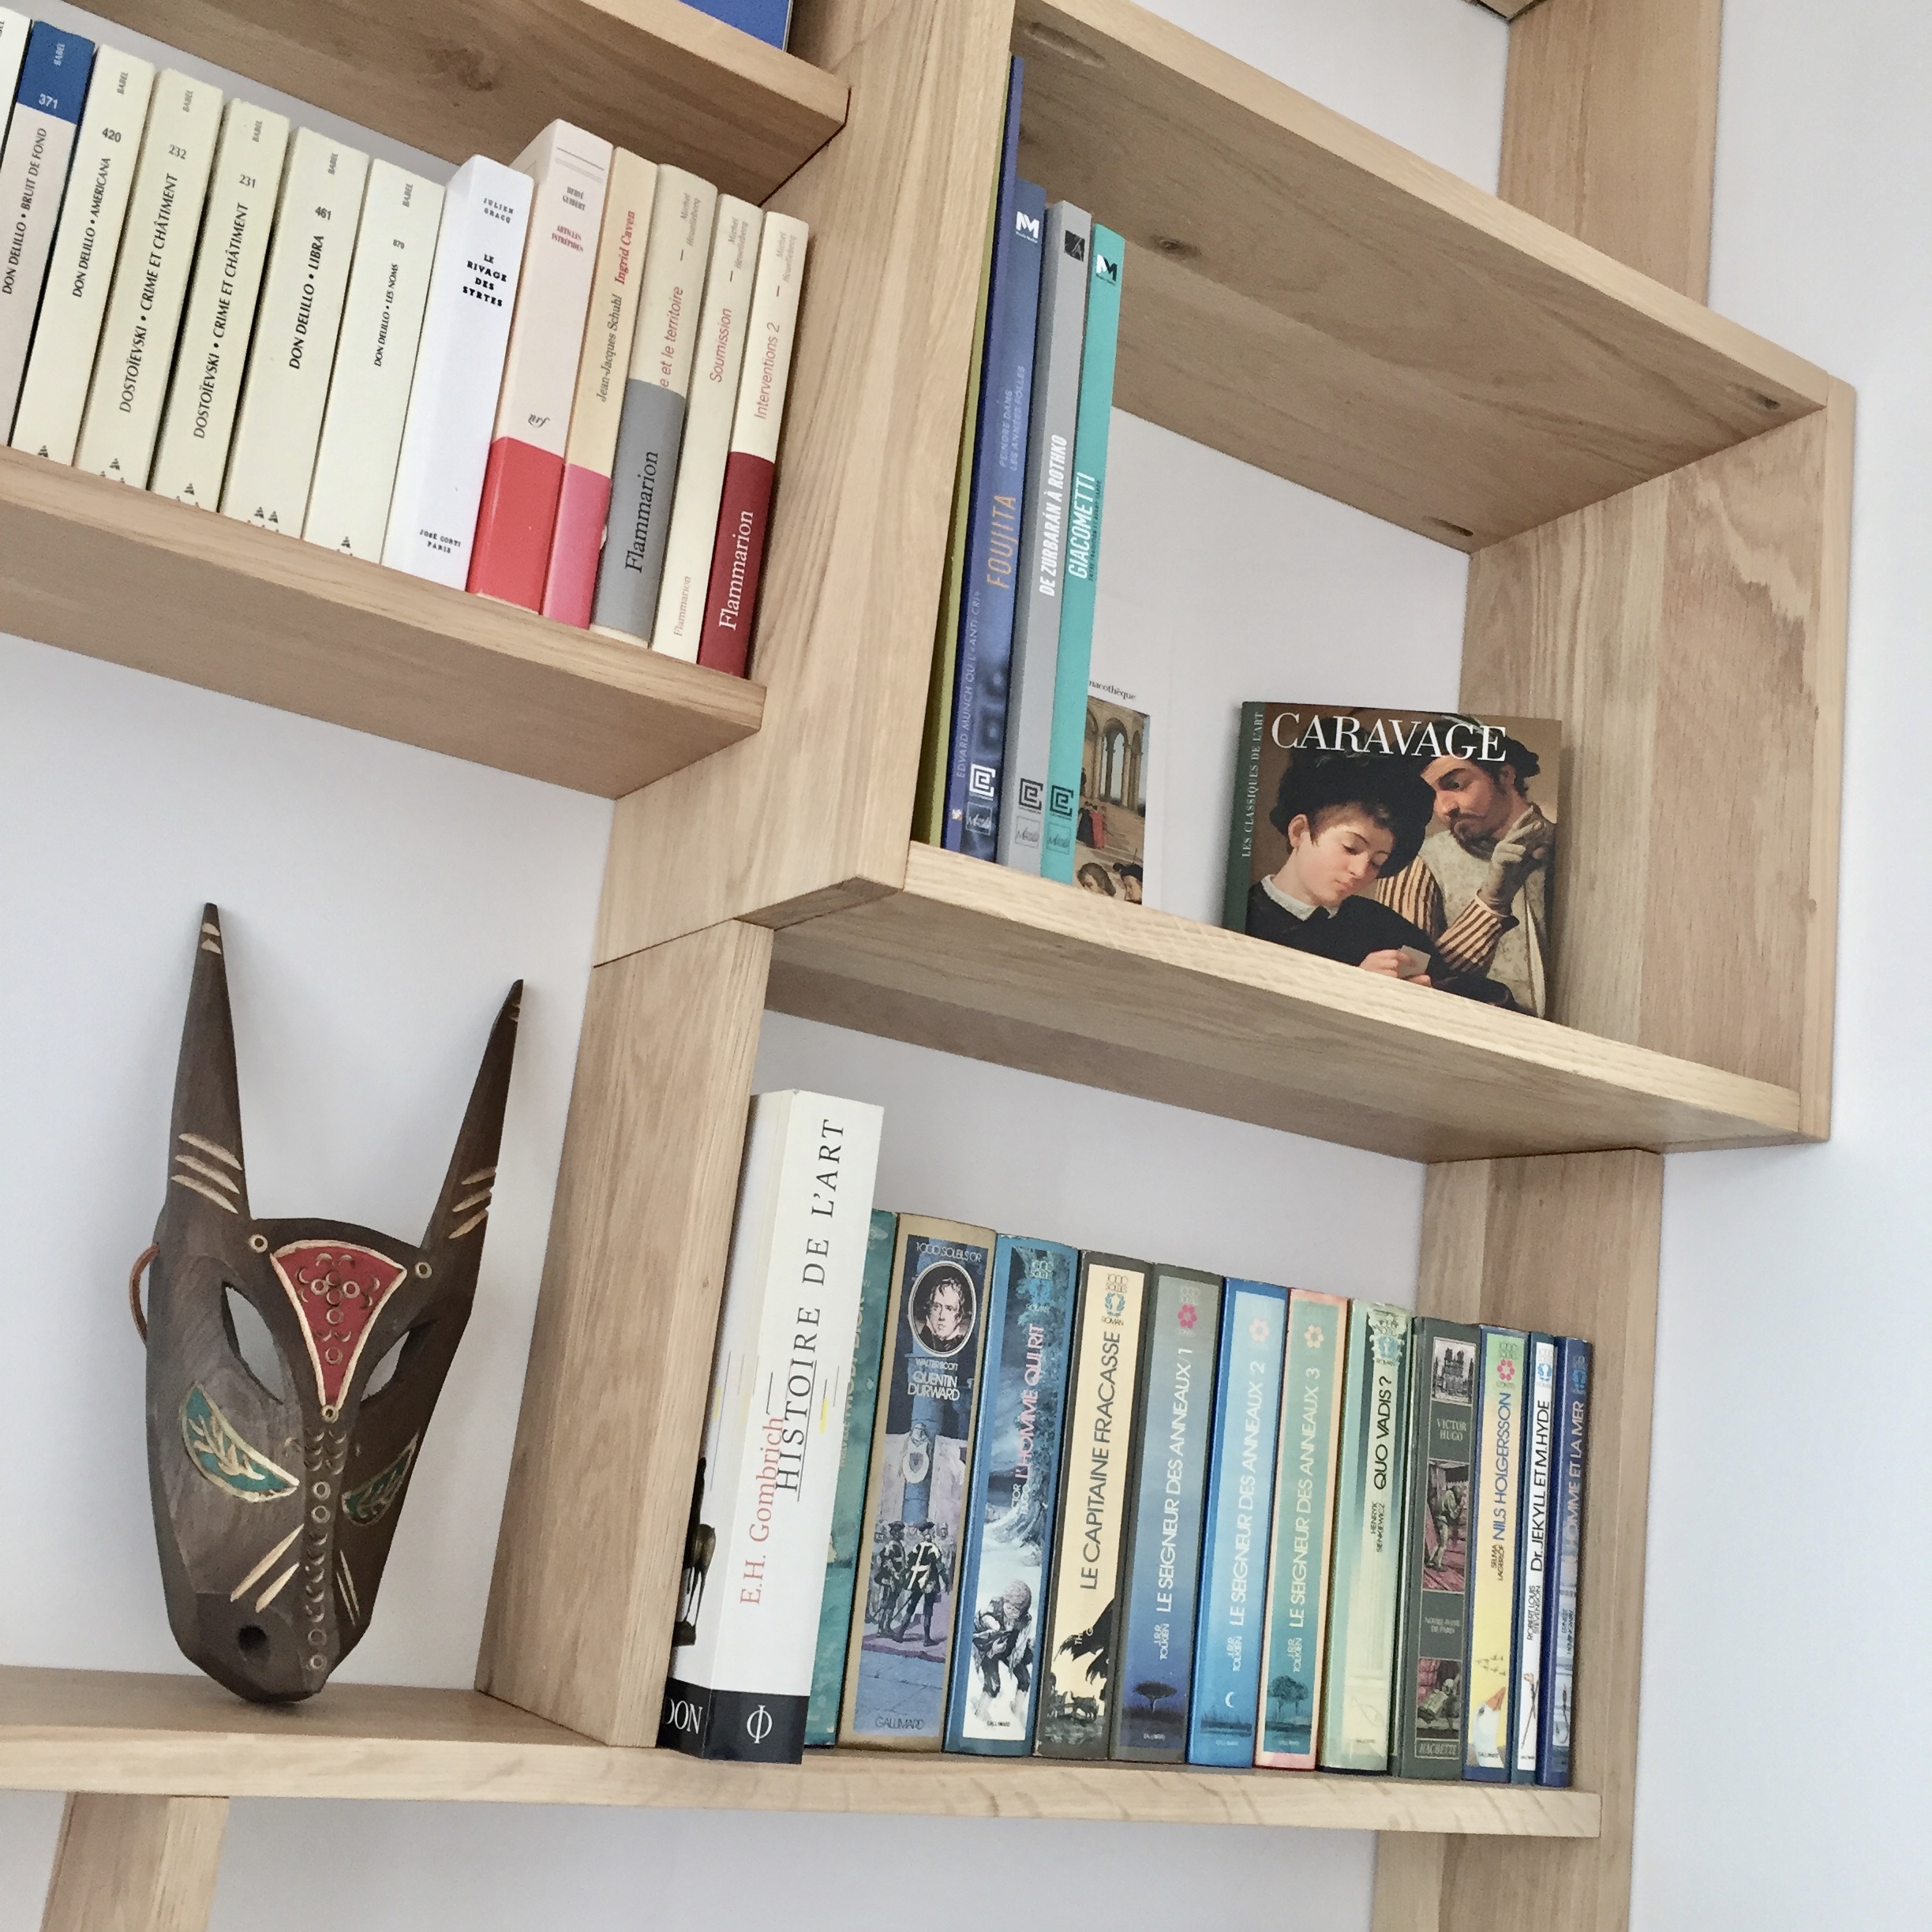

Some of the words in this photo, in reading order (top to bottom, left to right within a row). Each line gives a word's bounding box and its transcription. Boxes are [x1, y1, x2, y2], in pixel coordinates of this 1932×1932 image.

[117, 72, 129, 94] BABEL
[39, 93, 58, 110] 371
[182, 89, 193, 113] BABEL
[32, 128, 47, 161] FOND
[101, 128, 122, 143] 420
[252, 120, 263, 143] BABEL
[168, 144, 187, 160] 232
[328, 152, 339, 175] BABEL
[28, 161, 40, 178] DE
[238, 174, 256, 189] 231
[20, 178, 36, 212] BRUIT
[90, 158, 111, 219] AMERICANA
[402, 183, 414, 208] BABEL
[152, 174, 178, 251] CHÂTIMENT
[315, 206, 331, 221] 461
[483, 197, 514, 215] JULIEN
[484, 208, 511, 224] GRACQ
[224, 202, 249, 279] CHÂTIMENT
[620, 210, 635, 248] Caven
[8, 221, 27, 271] DELILLO
[78, 227, 96, 271] DELILLO
[148, 251, 163, 269] ET
[307, 235, 324, 271] LIBRA
[484, 253, 495, 264] LE
[2, 268, 17, 295] DON
[388, 264, 399, 289] NOMS
[466, 260, 507, 283] RIVAGE
[614, 246, 630, 286] Ingrid
[72, 271, 86, 297] DON
[140, 269, 159, 311] CRIME
[220, 279, 234, 298] ET
[384, 290, 395, 305] LES
[462, 286, 503, 307] SYRTES
[475, 277, 495, 290] DES
[212, 298, 232, 339] CRIME
[295, 283, 315, 336] DELILLO
[606, 293, 623, 331] Schuhl
[664, 286, 683, 343] territoire
[377, 311, 391, 346] DELILLO
[289, 336, 305, 369] DON
[373, 346, 384, 367] DON
[661, 343, 676, 360] le
[710, 307, 732, 384] Soumission
[119, 325, 148, 414] DOSTOÏEVSKI
[596, 332, 617, 403] Jean-Jacques
[660, 360, 673, 376] et
[754, 336, 778, 421] Interventions
[766, 321, 781, 333] 2
[193, 352, 221, 440] DOSTOÏEVSKI
[527, 413, 551, 428] nrf
[1046, 434, 1068, 492] ROTHKO
[624, 450, 660, 574] Flammarion
[1043, 491, 1063, 504] À
[987, 494, 1019, 590] FOUJITA
[1040, 502, 1062, 577] ZURBARÁN
[1068, 471, 1096, 580] GIACOMETTI
[427, 541, 451, 555] PARIS
[718, 510, 754, 632] Flammarion
[1039, 575, 1056, 597] DE
[673, 575, 691, 637] Flammarion
[965, 662, 975, 683] OU
[962, 686, 973, 731] MUNCH
[1251, 746, 1261, 760] DE
[1271, 712, 1507, 762] CARAVAGE
[956, 732, 969, 779] EDVARD
[1245, 765, 1260, 833] CLASSIQUES
[1241, 837, 1252, 857] LES
[811, 1118, 844, 1219] L'ART
[802, 1238, 829, 1286] DE
[915, 1241, 941, 1256] 1000
[1028, 1323, 1045, 1347] RIT
[1101, 1315, 1125, 1327] ROMAN
[912, 1370, 958, 1388] QUENTIN
[1024, 1346, 1043, 1387] QUI
[1249, 1360, 1266, 1374] 2
[1305, 1367, 1320, 1380] 3
[776, 1307, 821, 1492] HISTOIRE
[908, 1382, 960, 1402] DURWARD
[1095, 1331, 1121, 1443] FRACASSE
[1242, 1382, 1264, 1473] ANNEAUX
[1300, 1384, 1320, 1477] ANNEAUX
[1376, 1388, 1392, 1440] VADIS
[1436, 1418, 1467, 1432] VICTOR
[1571, 1400, 1585, 1436] MER
[1015, 1391, 1039, 1480] L'HOMME
[1440, 1430, 1464, 1443] HUGO
[1494, 1392, 1512, 1505] HOLGERSSON
[1570, 1439, 1583, 1458] LA
[749, 1417, 784, 1543] Gombrich
[1166, 1458, 1184, 1496] DES
[1373, 1443, 1388, 1490] QUO
[1533, 1469, 1546, 1487] ET
[1569, 1460, 1582, 1478] ET
[1084, 1446, 1110, 1563] CAPITAINE
[1238, 1475, 1256, 1511] DES
[1296, 1478, 1313, 1515] DES
[1492, 1507, 1507, 1541] NILS
[1158, 1498, 1181, 1591] SEIGNEUR
[1230, 1514, 1252, 1607] SEIGNEUR
[1080, 1567, 1099, 1590] LE
[1291, 1516, 1311, 1608] SEIGNEUR
[1155, 1592, 1173, 1613] LE
[1229, 1606, 1245, 1627] LE
[1289, 1608, 1305, 1628] LE
[874, 1717, 925, 1731] GALLIMARD
[1420, 1743, 1458, 1756] HACHETTE
